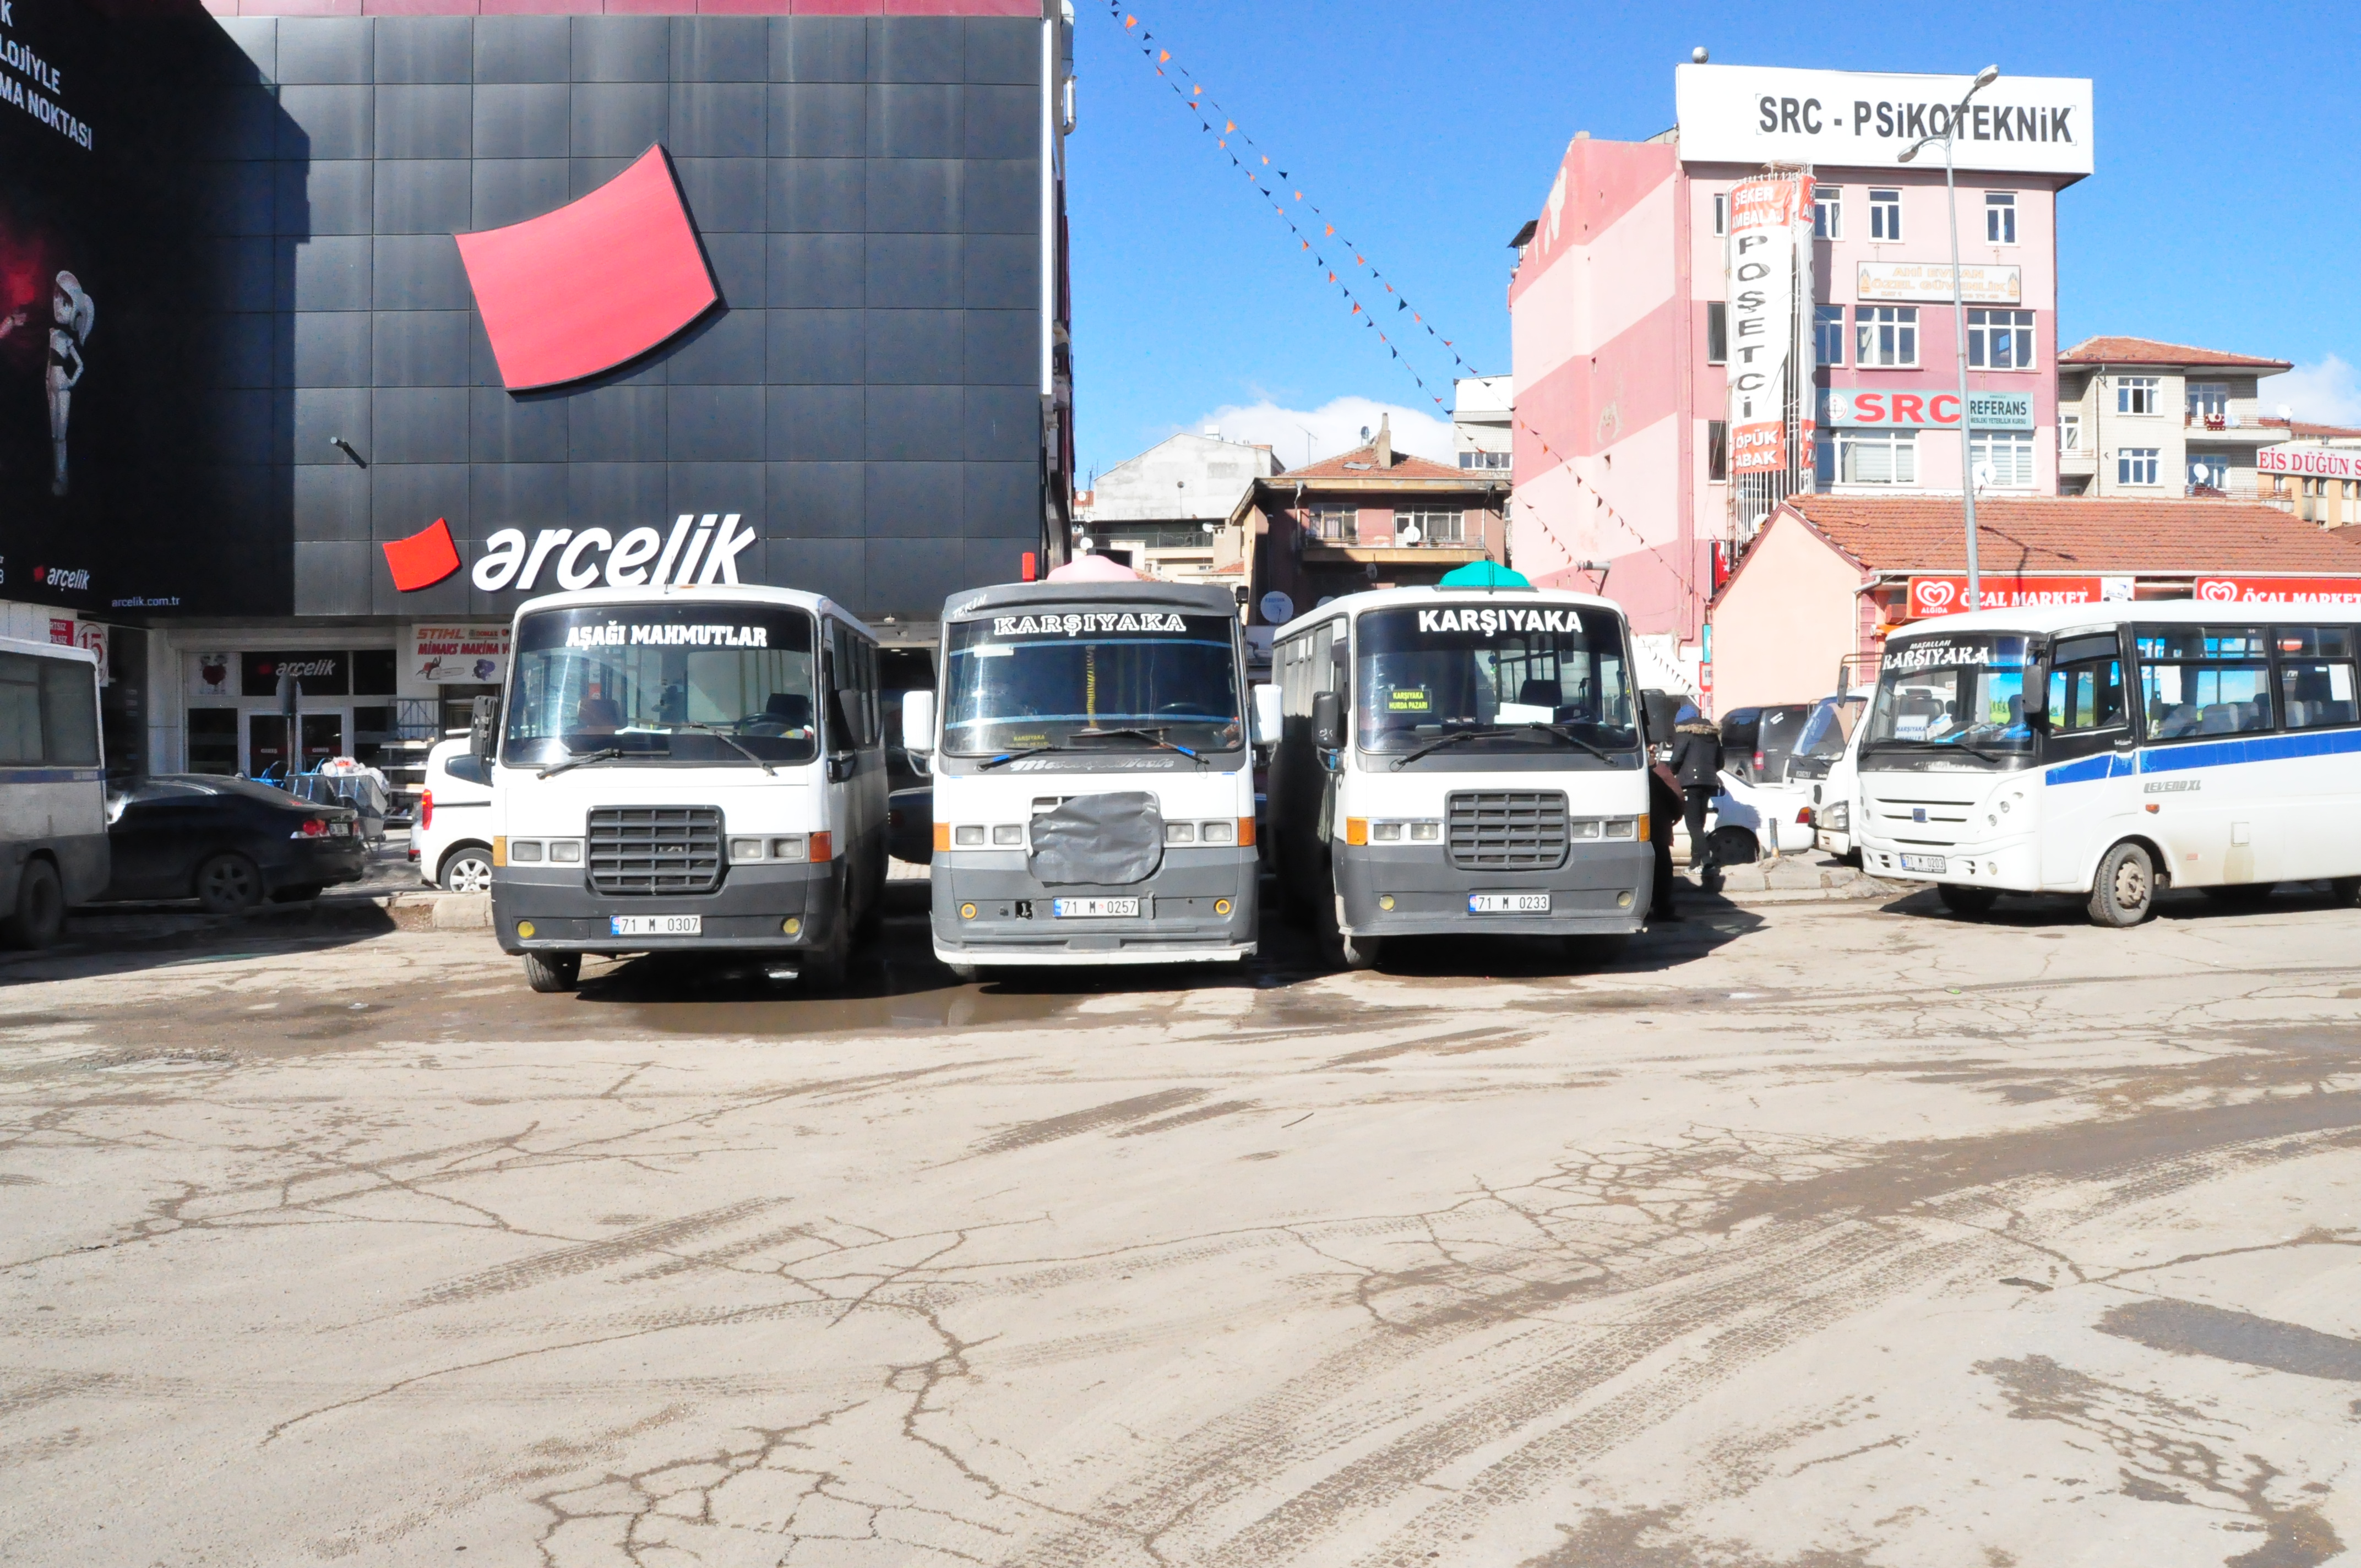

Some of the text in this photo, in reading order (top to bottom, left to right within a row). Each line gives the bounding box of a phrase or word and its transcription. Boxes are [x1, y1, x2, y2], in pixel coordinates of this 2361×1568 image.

[28, 89, 92, 151] NOKTASI
[1759, 96, 1823, 134] SRC
[1736, 186, 1774, 210] ŞEKER
[1872, 279, 1915, 289] ÖZEL
[1854, 393, 1961, 423] SRC
[1970, 400, 2027, 416] REFERANS
[2259, 447, 2287, 470] EİS
[2291, 451, 2349, 475] DÜĞÜN
[112, 596, 181, 607] arcelik.com.tr
[2011, 591, 2088, 607] MARKET
[994, 613, 1187, 637] KARŞIYAKA
[1418, 609, 1583, 637] KARŞIYAKA
[416, 628, 465, 639] STIHL
[565, 620, 768, 651] AŞAĞI MAHMUTLAR
[81, 631, 103, 665] 15
[460, 640, 499, 655] MAKİNA
[1910, 639, 1952, 650] MAŞALLAH
[1882, 646, 1990, 670] KARŞIYAKA
[1392, 692, 1424, 701] KARŞIYAKA
[1388, 701, 1428, 710] HURDA PAZARI
[1906, 856, 1913, 866] 71
[1927, 857, 1944, 868] 0203
[1064, 901, 1136, 913] 71 M 0257
[1479, 896, 1547, 909] 71 M 0233
[622, 918, 698, 932] 71 M 0307
